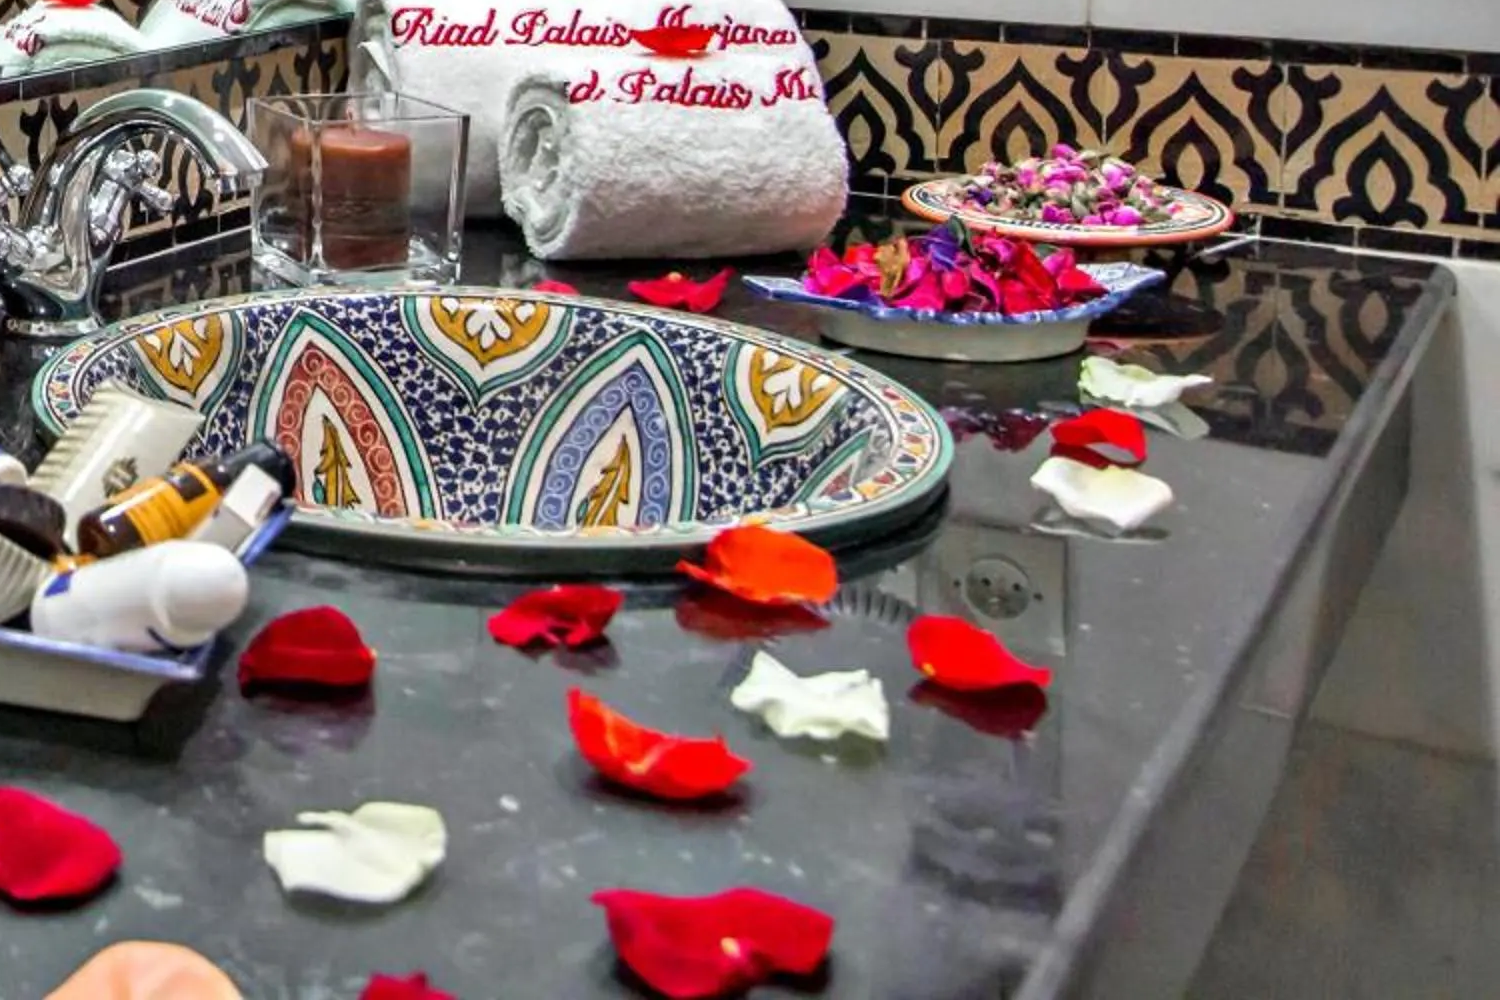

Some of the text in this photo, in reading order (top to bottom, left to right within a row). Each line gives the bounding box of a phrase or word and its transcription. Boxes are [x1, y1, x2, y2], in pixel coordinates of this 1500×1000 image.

[392, 7, 499, 48] Riad
[504, 9, 631, 47] Palais
[612, 67, 752, 109] Palais
